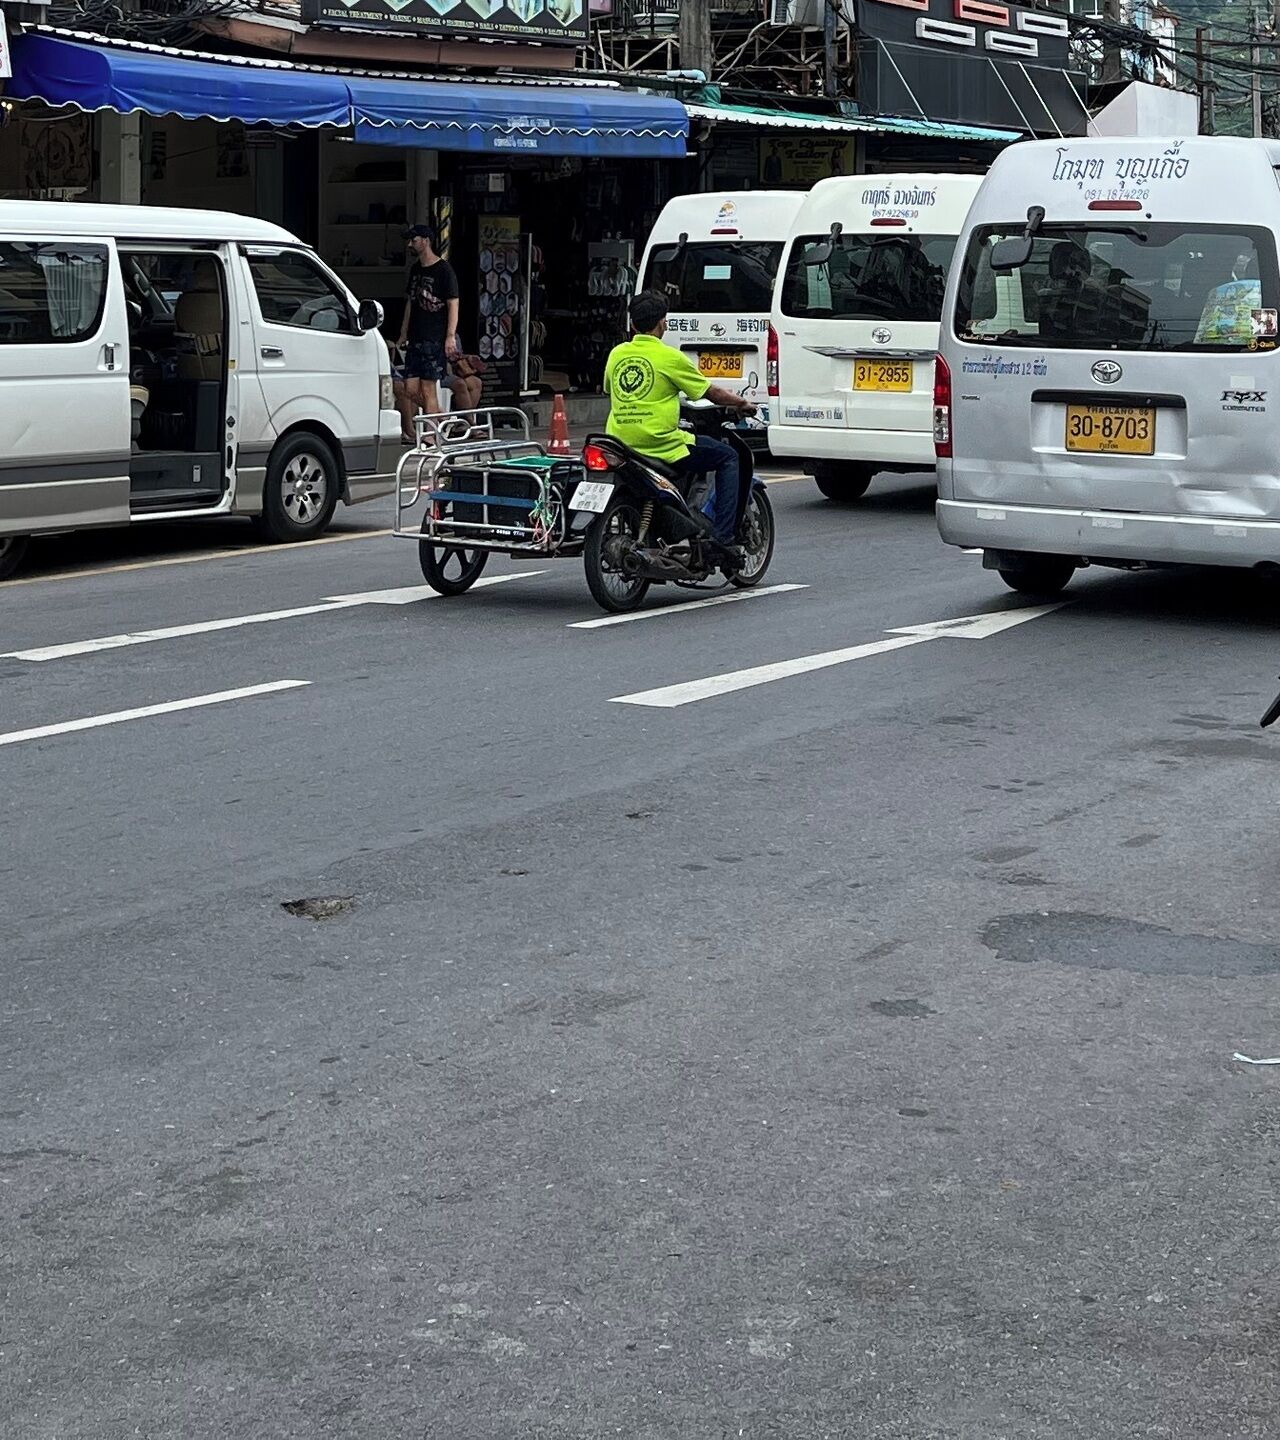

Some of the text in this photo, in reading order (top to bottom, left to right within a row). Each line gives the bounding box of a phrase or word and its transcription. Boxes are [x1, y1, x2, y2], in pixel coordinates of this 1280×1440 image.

[1052, 139, 1190, 190] โกมุท บุญเกื้อ
[699, 357, 741, 371] 30-7389
[858, 366, 909, 383] 31-2955
[1086, 406, 1134, 415] THAILAND
[1222, 404, 1266, 413] COMMUTER
[1070, 415, 1149, 440] 30-8703
